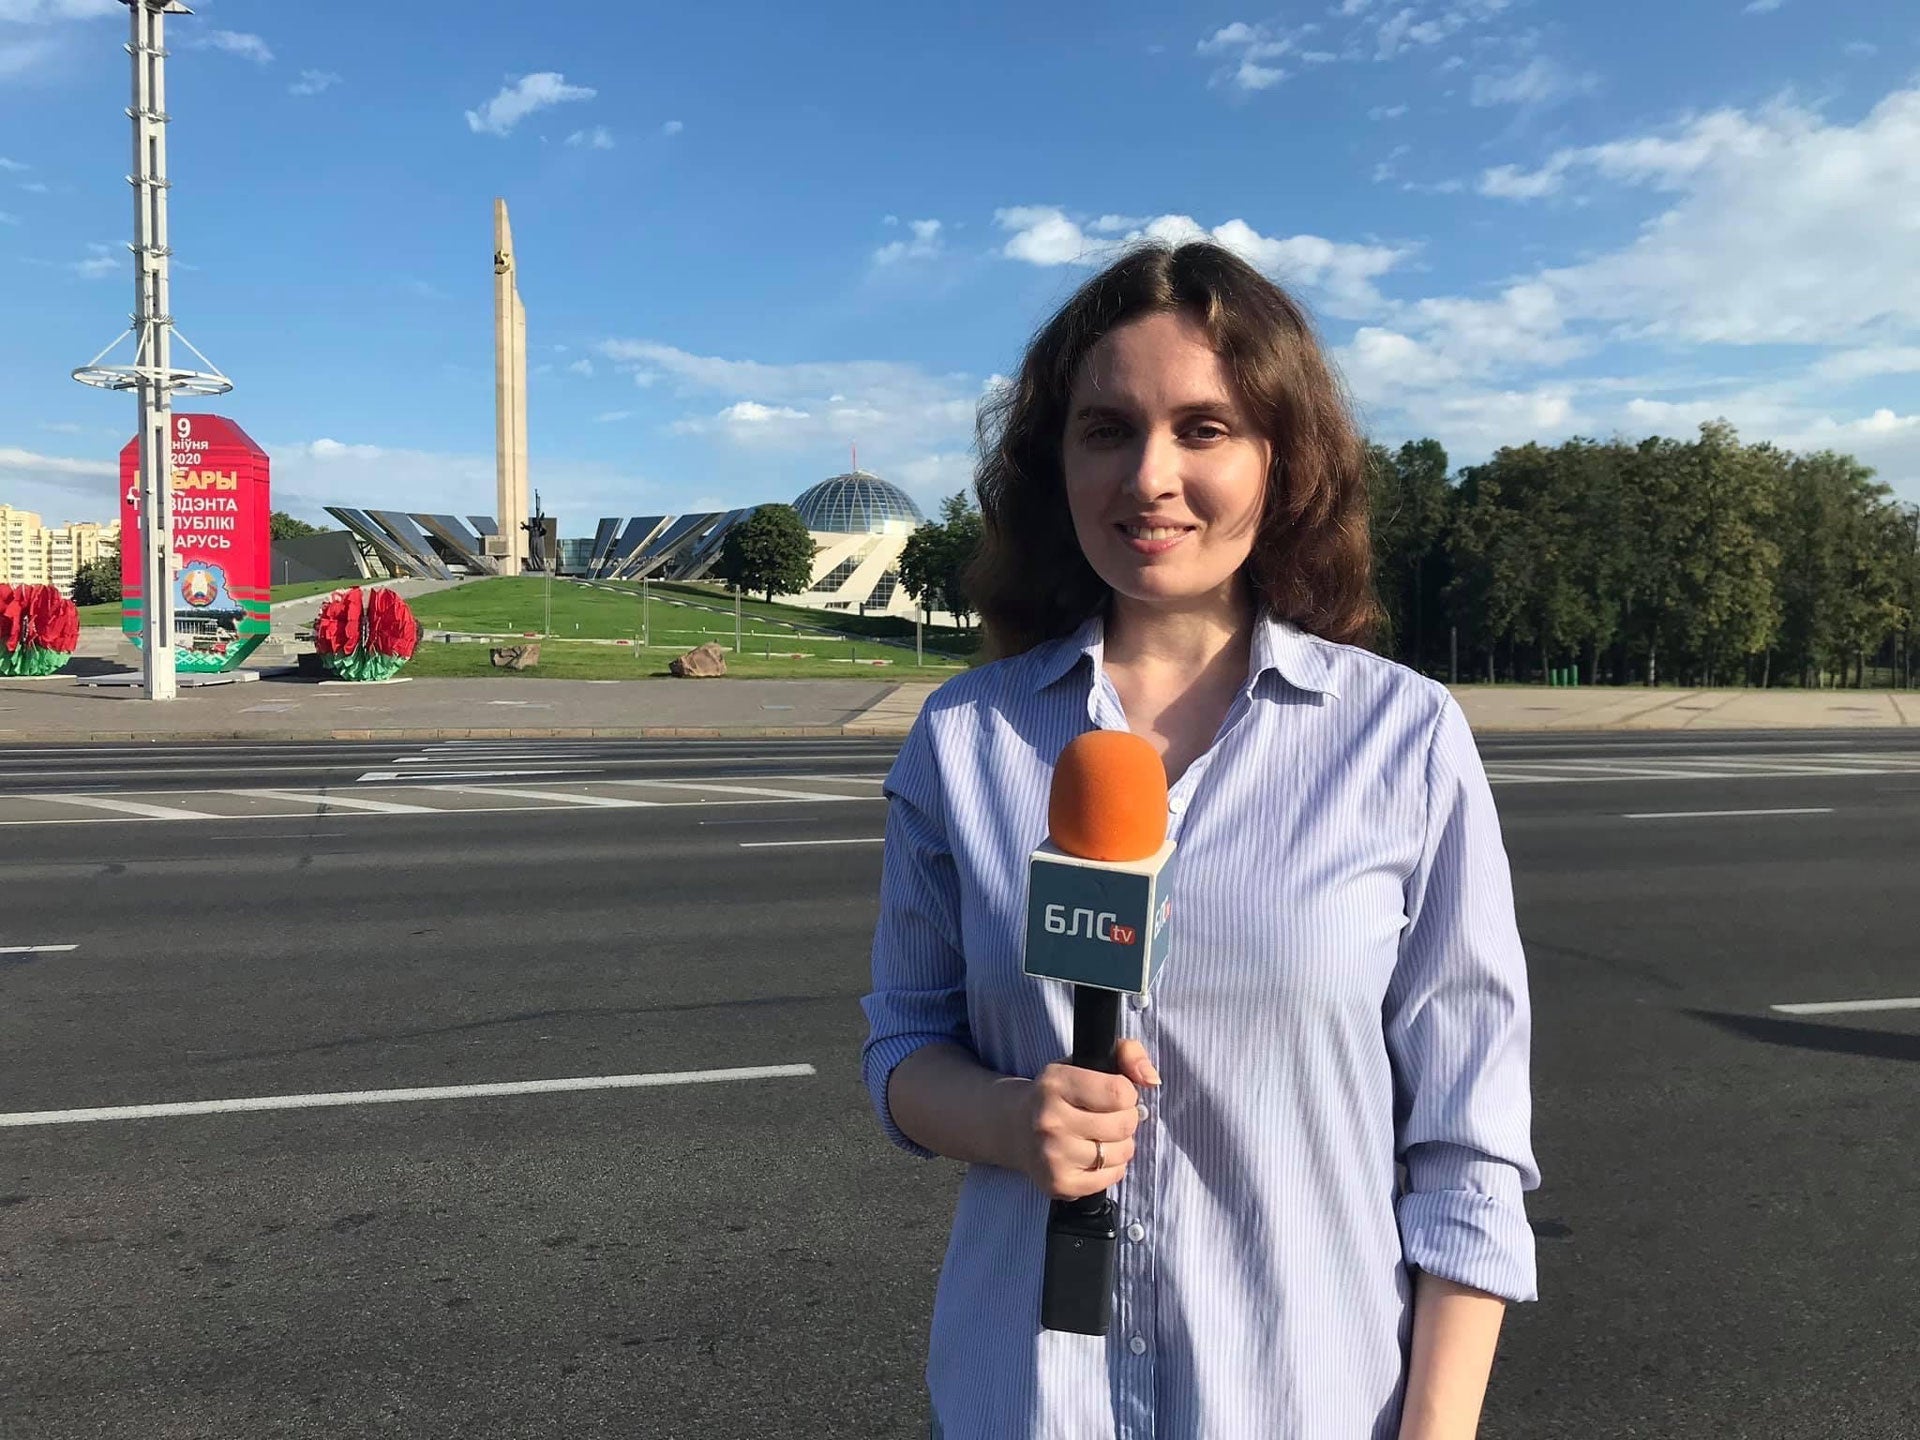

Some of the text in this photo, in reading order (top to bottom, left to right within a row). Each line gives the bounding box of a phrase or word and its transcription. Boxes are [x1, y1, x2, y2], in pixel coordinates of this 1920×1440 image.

[177, 417, 191, 438] 9
[171, 438, 209, 452] ніўня
[171, 453, 201, 464] 2020
[175, 535, 231, 548] АРУСЬ
